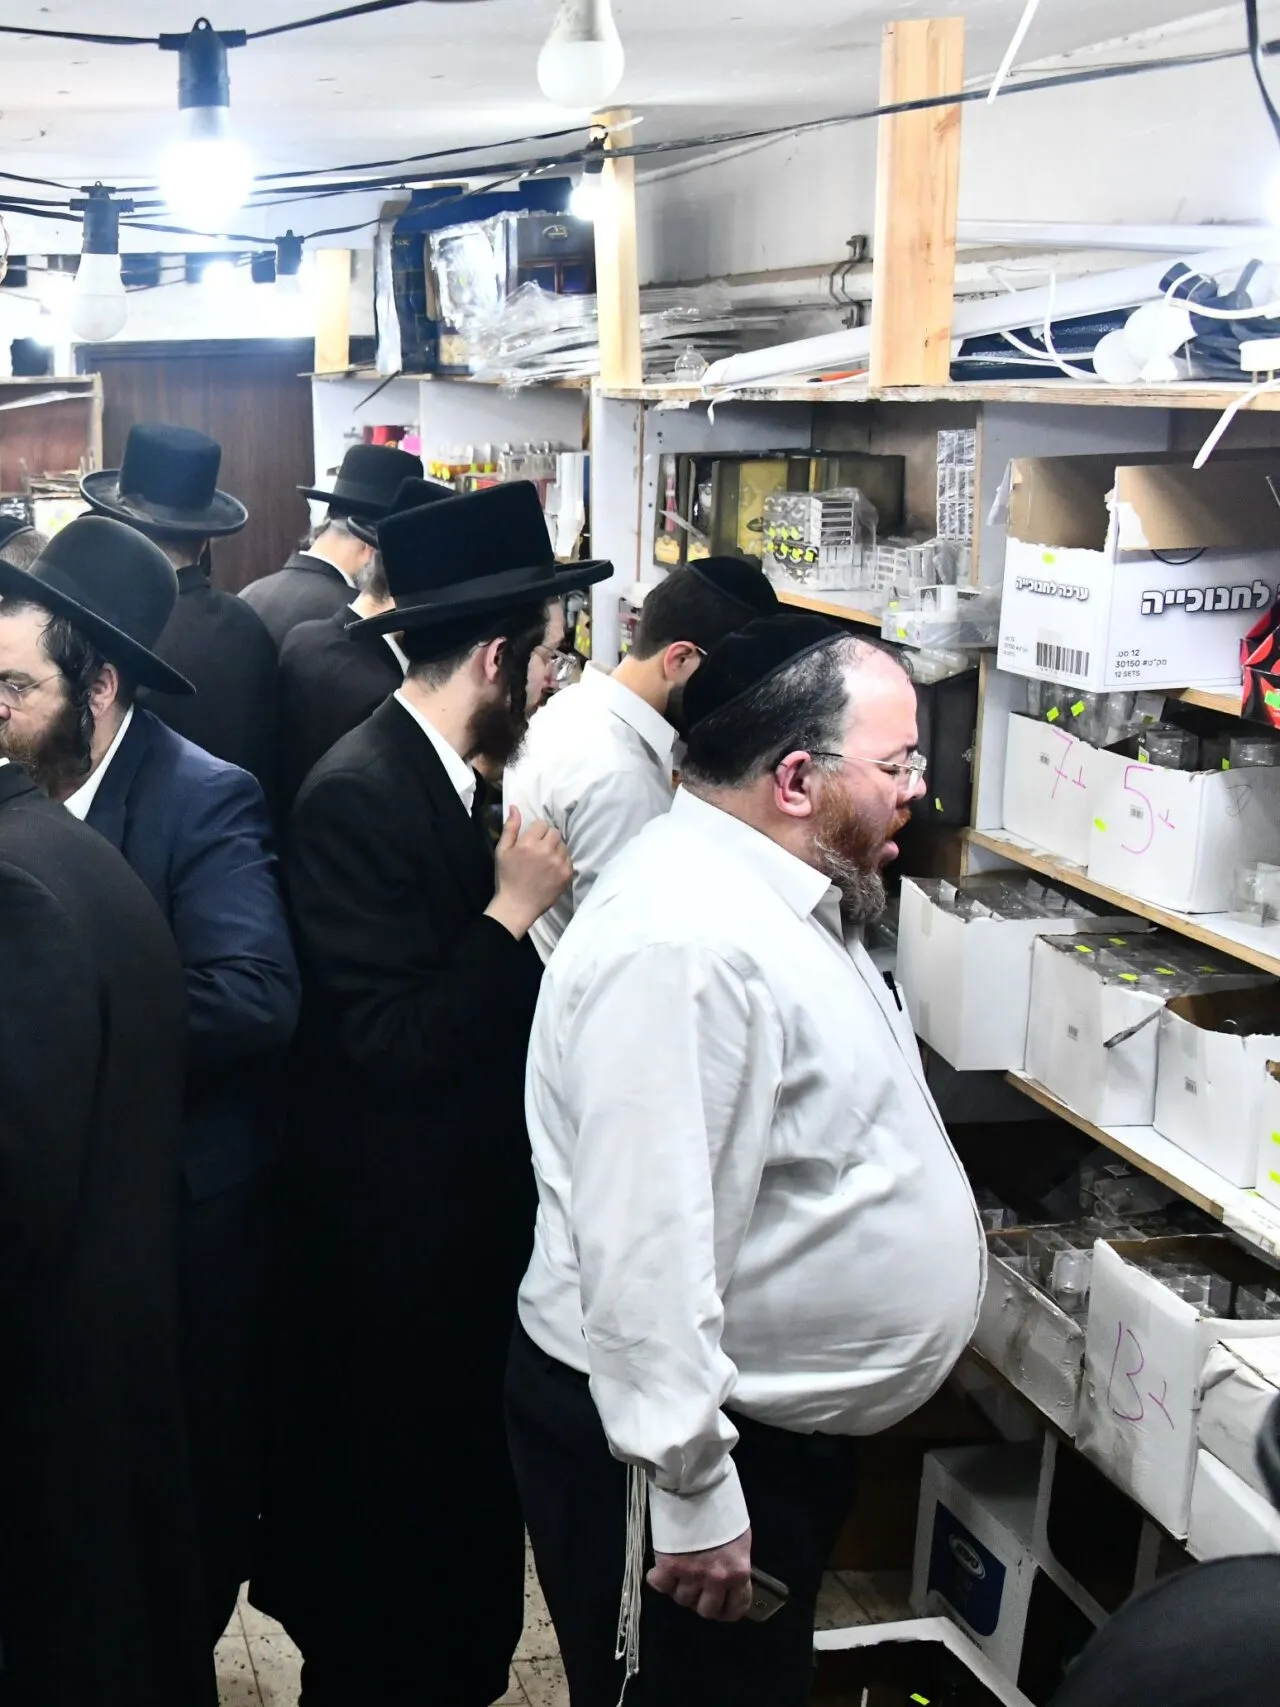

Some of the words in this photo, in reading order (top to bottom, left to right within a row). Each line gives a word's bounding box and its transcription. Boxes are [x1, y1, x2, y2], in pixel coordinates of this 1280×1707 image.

[1015, 576, 1058, 596] לחנוכייה
[1058, 584, 1090, 602] ערכה
[1140, 579, 1271, 616] לחנוכייה
[1115, 659, 1141, 669] 30150
[1123, 670, 1141, 678] SETS
